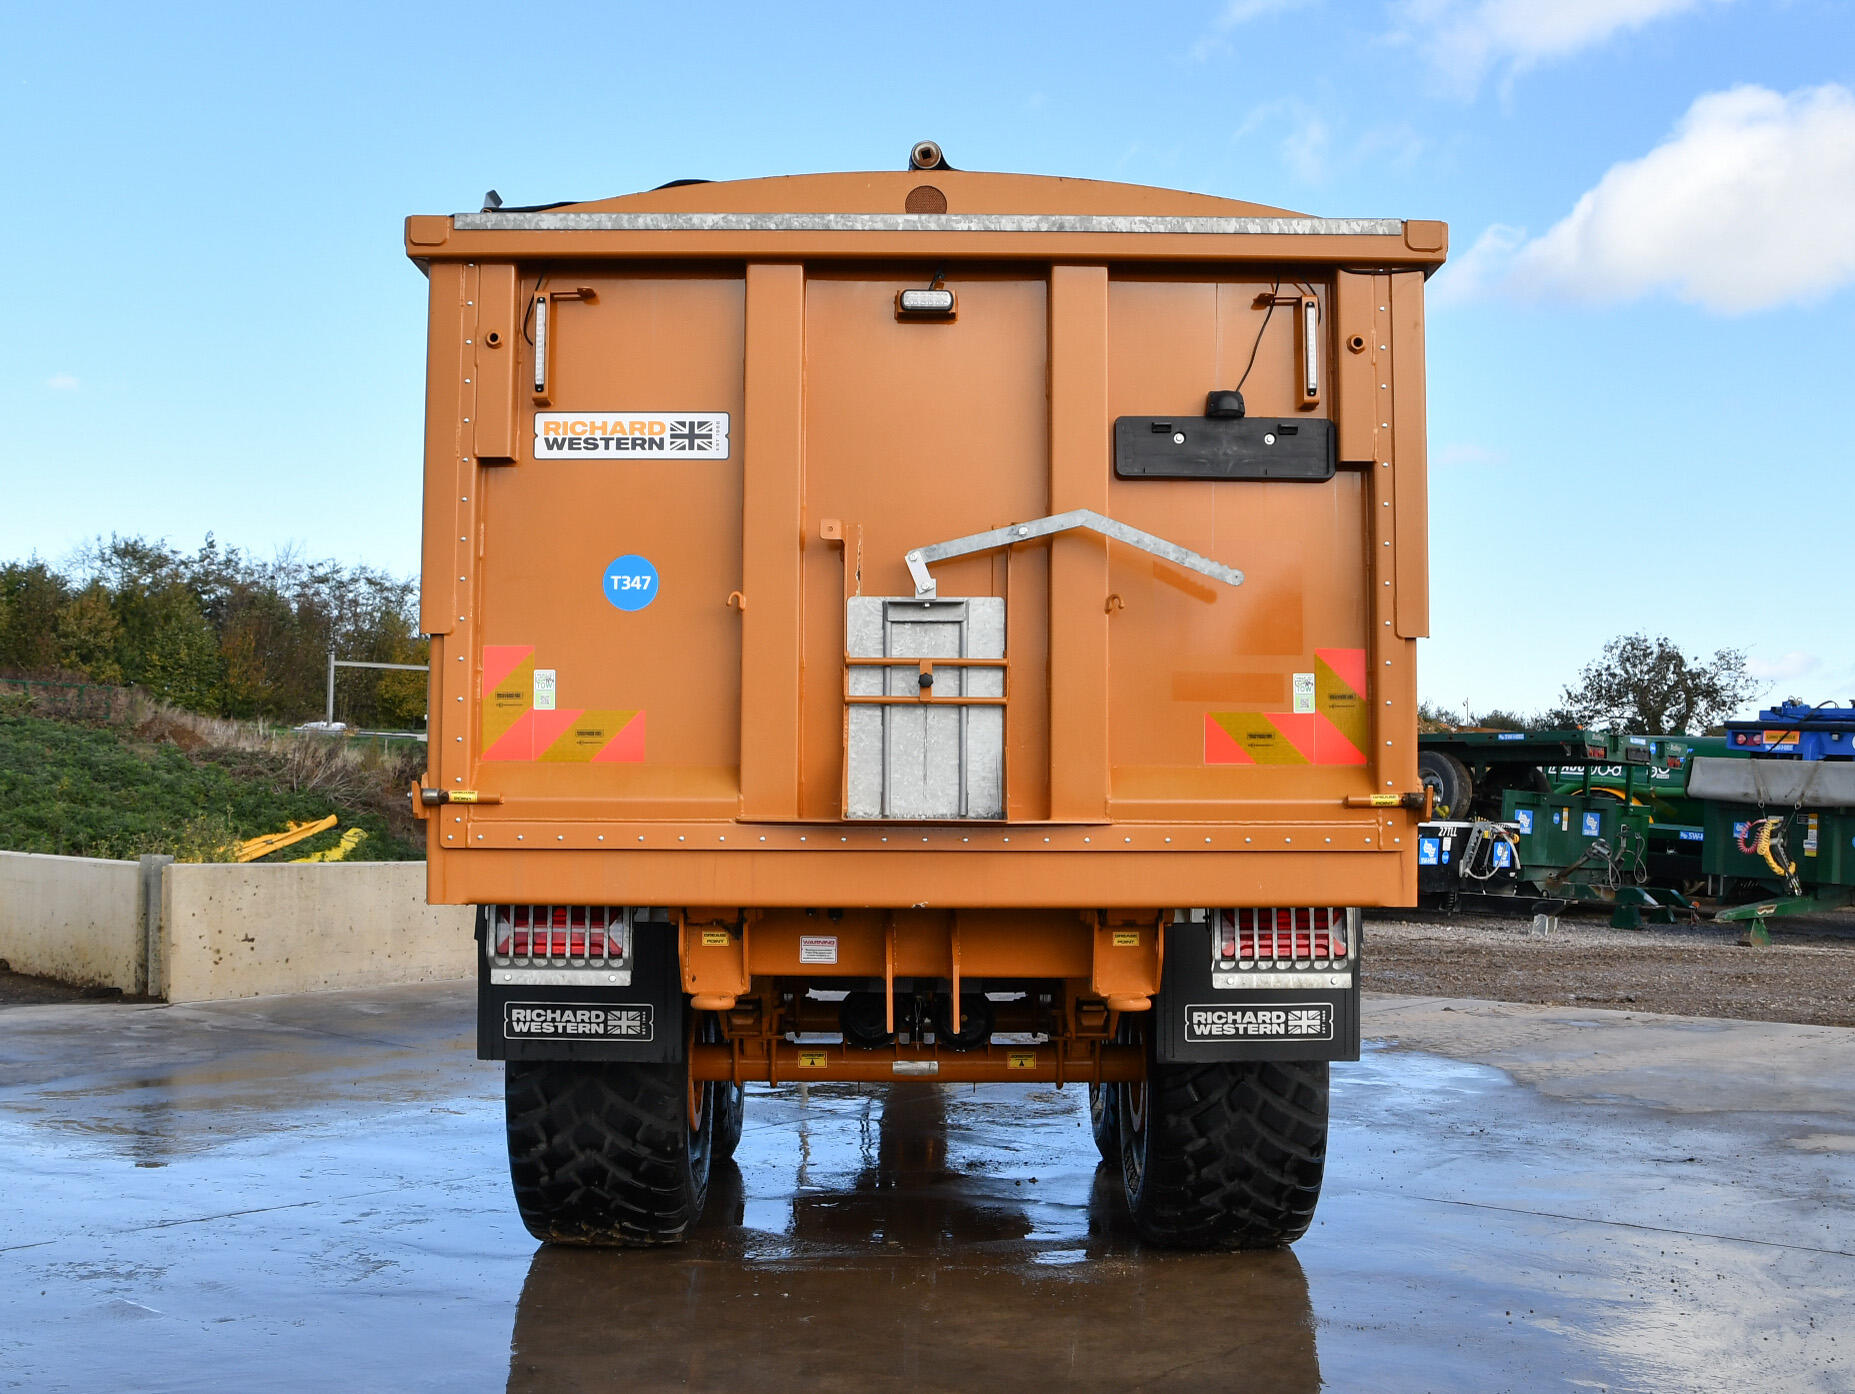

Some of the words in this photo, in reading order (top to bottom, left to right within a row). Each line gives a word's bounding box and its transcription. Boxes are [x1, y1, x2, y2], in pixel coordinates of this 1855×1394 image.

[544, 420, 666, 436] RICHARD
[544, 437, 665, 451] WESTERN
[610, 575, 652, 591] T347
[511, 1009, 605, 1024] RICHARD
[1192, 1010, 1286, 1024] RICHARD
[512, 1021, 604, 1035] WESTERN
[1193, 1023, 1285, 1036] WESTERN
